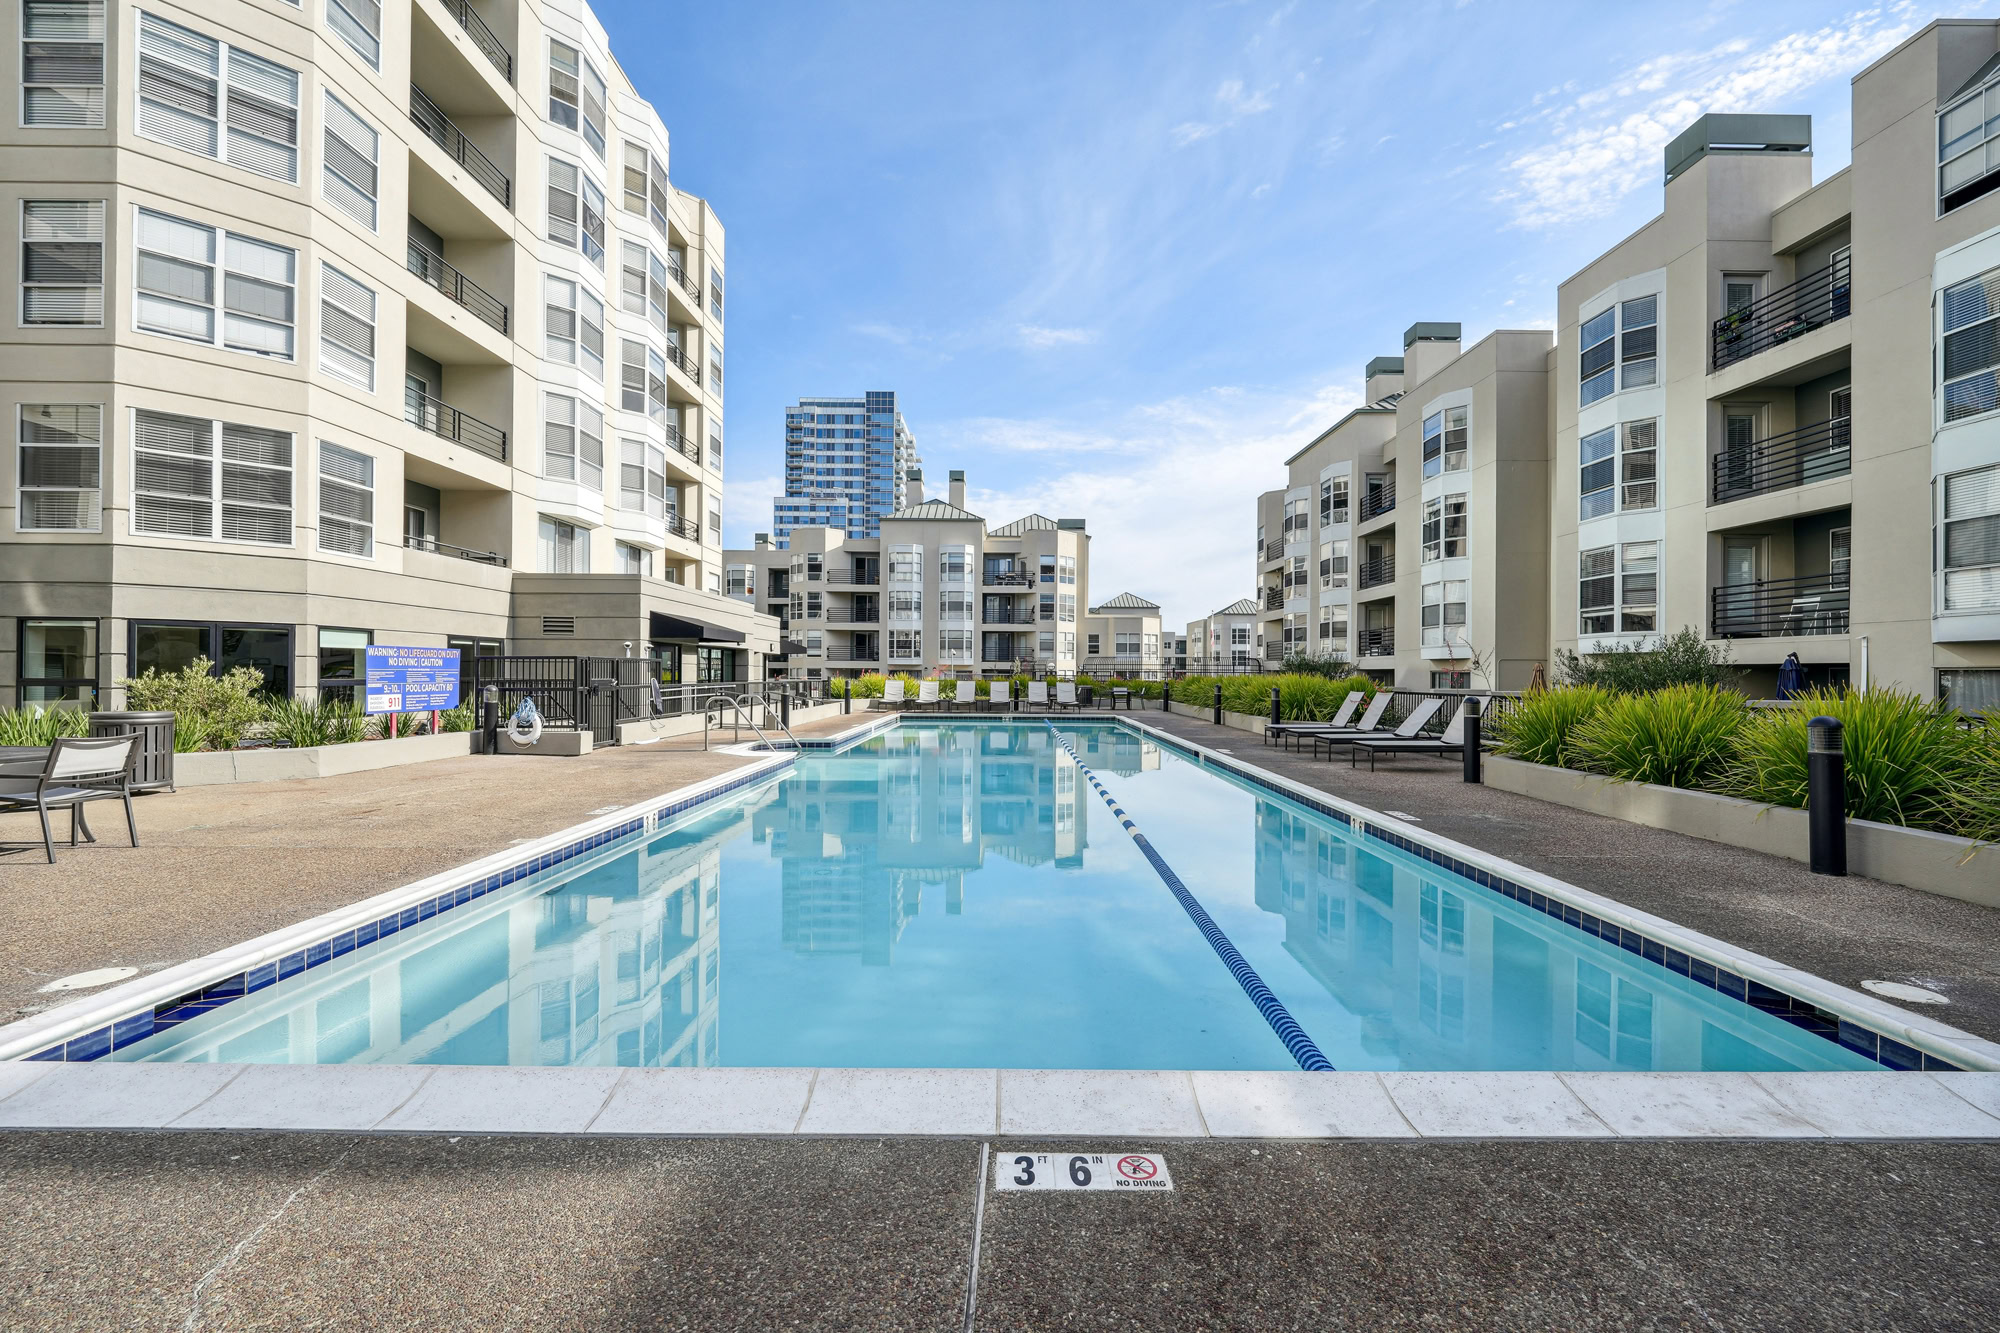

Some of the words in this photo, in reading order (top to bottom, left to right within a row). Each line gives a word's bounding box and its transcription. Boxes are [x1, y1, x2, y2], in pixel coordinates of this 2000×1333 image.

[368, 648, 398, 656] WARNING:
[400, 648, 408, 656] NO
[409, 649, 438, 658] LIFEGUARD
[446, 650, 459, 658] DUTY
[388, 658, 398, 666] NO
[398, 658, 418, 666] DIVING
[421, 658, 442, 666] CAUTION
[406, 684, 421, 692] POOL
[422, 684, 447, 692] CAPACITY
[388, 698, 400, 708] 911
[1014, 1156, 1036, 1186] 3
[1069, 1156, 1092, 1186] 6
